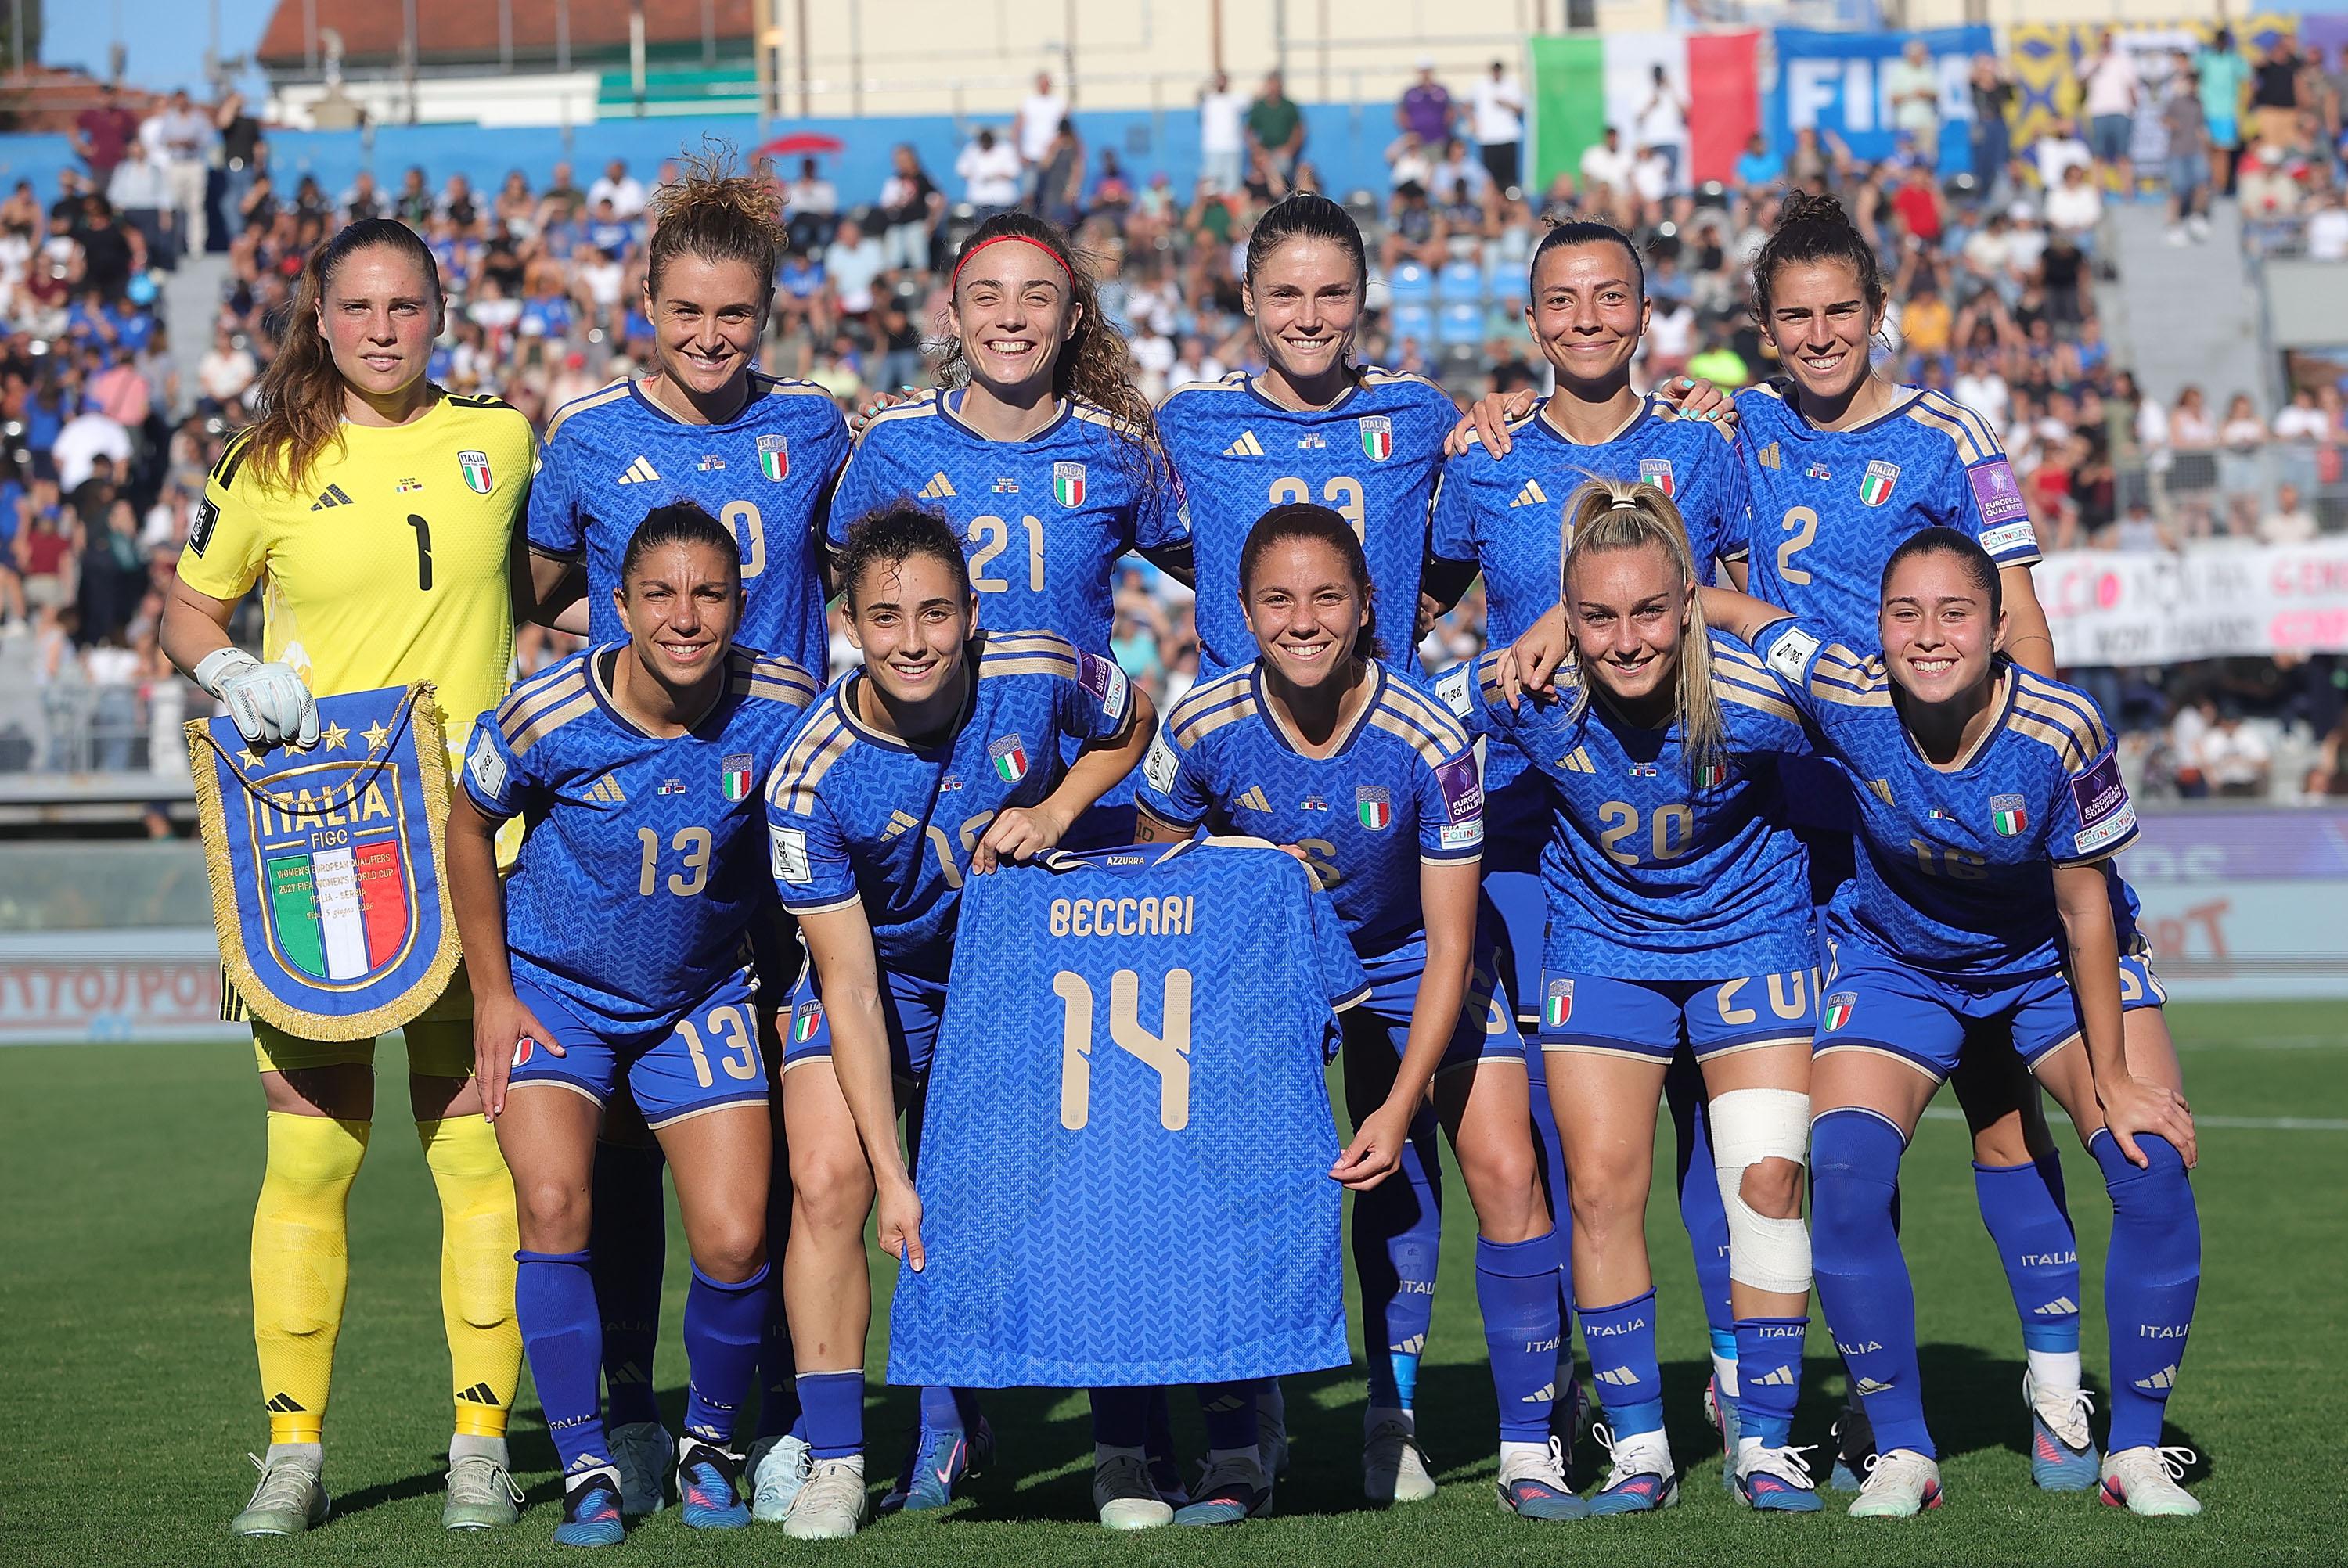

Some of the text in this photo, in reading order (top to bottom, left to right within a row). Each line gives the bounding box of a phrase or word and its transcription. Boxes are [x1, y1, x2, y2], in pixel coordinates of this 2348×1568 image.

[1787, 54, 1980, 133] FIA
[460, 454, 484, 463] ITALIA
[1057, 465, 1083, 477] ITALIA
[1643, 462, 1669, 471] ITALIA
[1871, 463, 1897, 477] ITALIA
[1986, 503, 2023, 516] QUALIFIERS
[406, 513, 433, 592] 1
[967, 515, 1045, 592] 21
[1777, 505, 1818, 585] 2
[260, 779, 392, 836] ITALIA
[2084, 784, 2119, 814] EUROPEAN
[2085, 790, 2122, 819] QUALIFIERS
[310, 828, 349, 851] FIGC
[1598, 800, 1694, 866] 20
[276, 853, 391, 879] WOMEN'S EUROPEAN QUALIFIERS
[637, 826, 712, 897] 13
[1107, 856, 1145, 866] AZZURRA
[278, 883, 296, 895] 2027
[297, 882, 313, 892] FIFA
[351, 870, 377, 883] WORLD
[379, 868, 394, 879] CUP
[309, 893, 333, 904] ITALIA
[1050, 895, 1194, 937] BECCARI
[800, 1002, 821, 1015] ITALIA
[675, 1005, 757, 1088] 13
[1053, 968, 1193, 1131] 14
[2021, 1251, 2077, 1268] ITALIA
[1586, 1318, 1645, 1336] ITALIA
[1759, 1325, 1805, 1338] ITALIA
